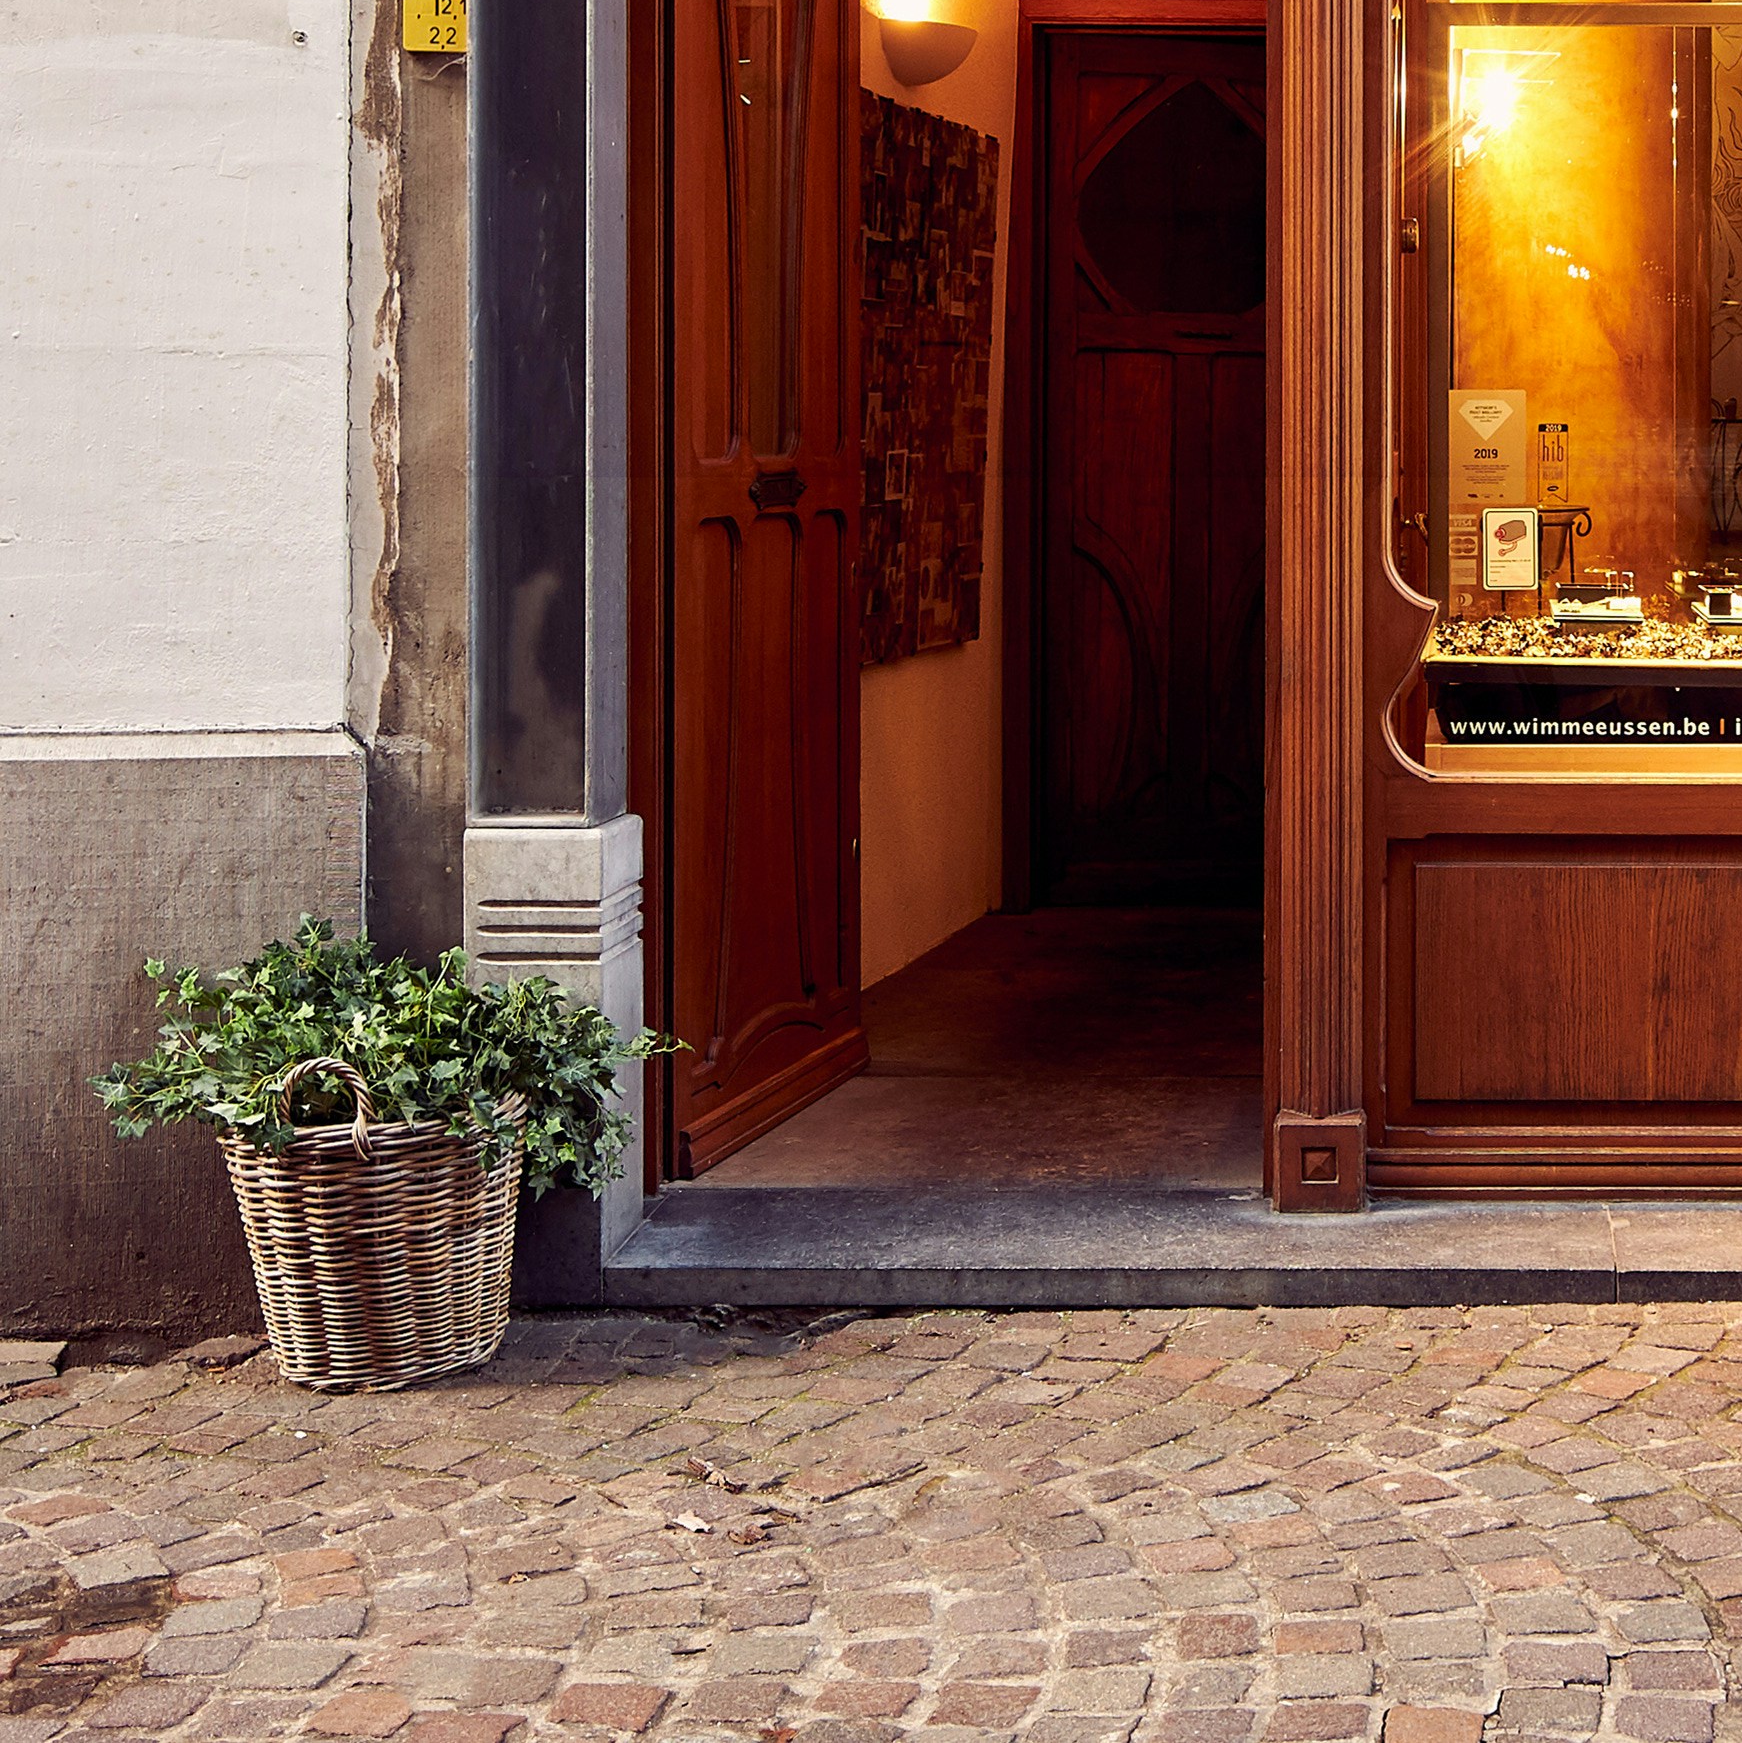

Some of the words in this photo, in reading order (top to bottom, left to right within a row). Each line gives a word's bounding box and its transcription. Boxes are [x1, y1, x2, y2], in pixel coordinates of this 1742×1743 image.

[429, 26, 457, 50] 2,2
[1545, 424, 1563, 432] 2019
[1473, 448, 1499, 459] 2019
[1542, 434, 1564, 462] hib
[1449, 717, 1711, 737] www.wimmeeussen.be
